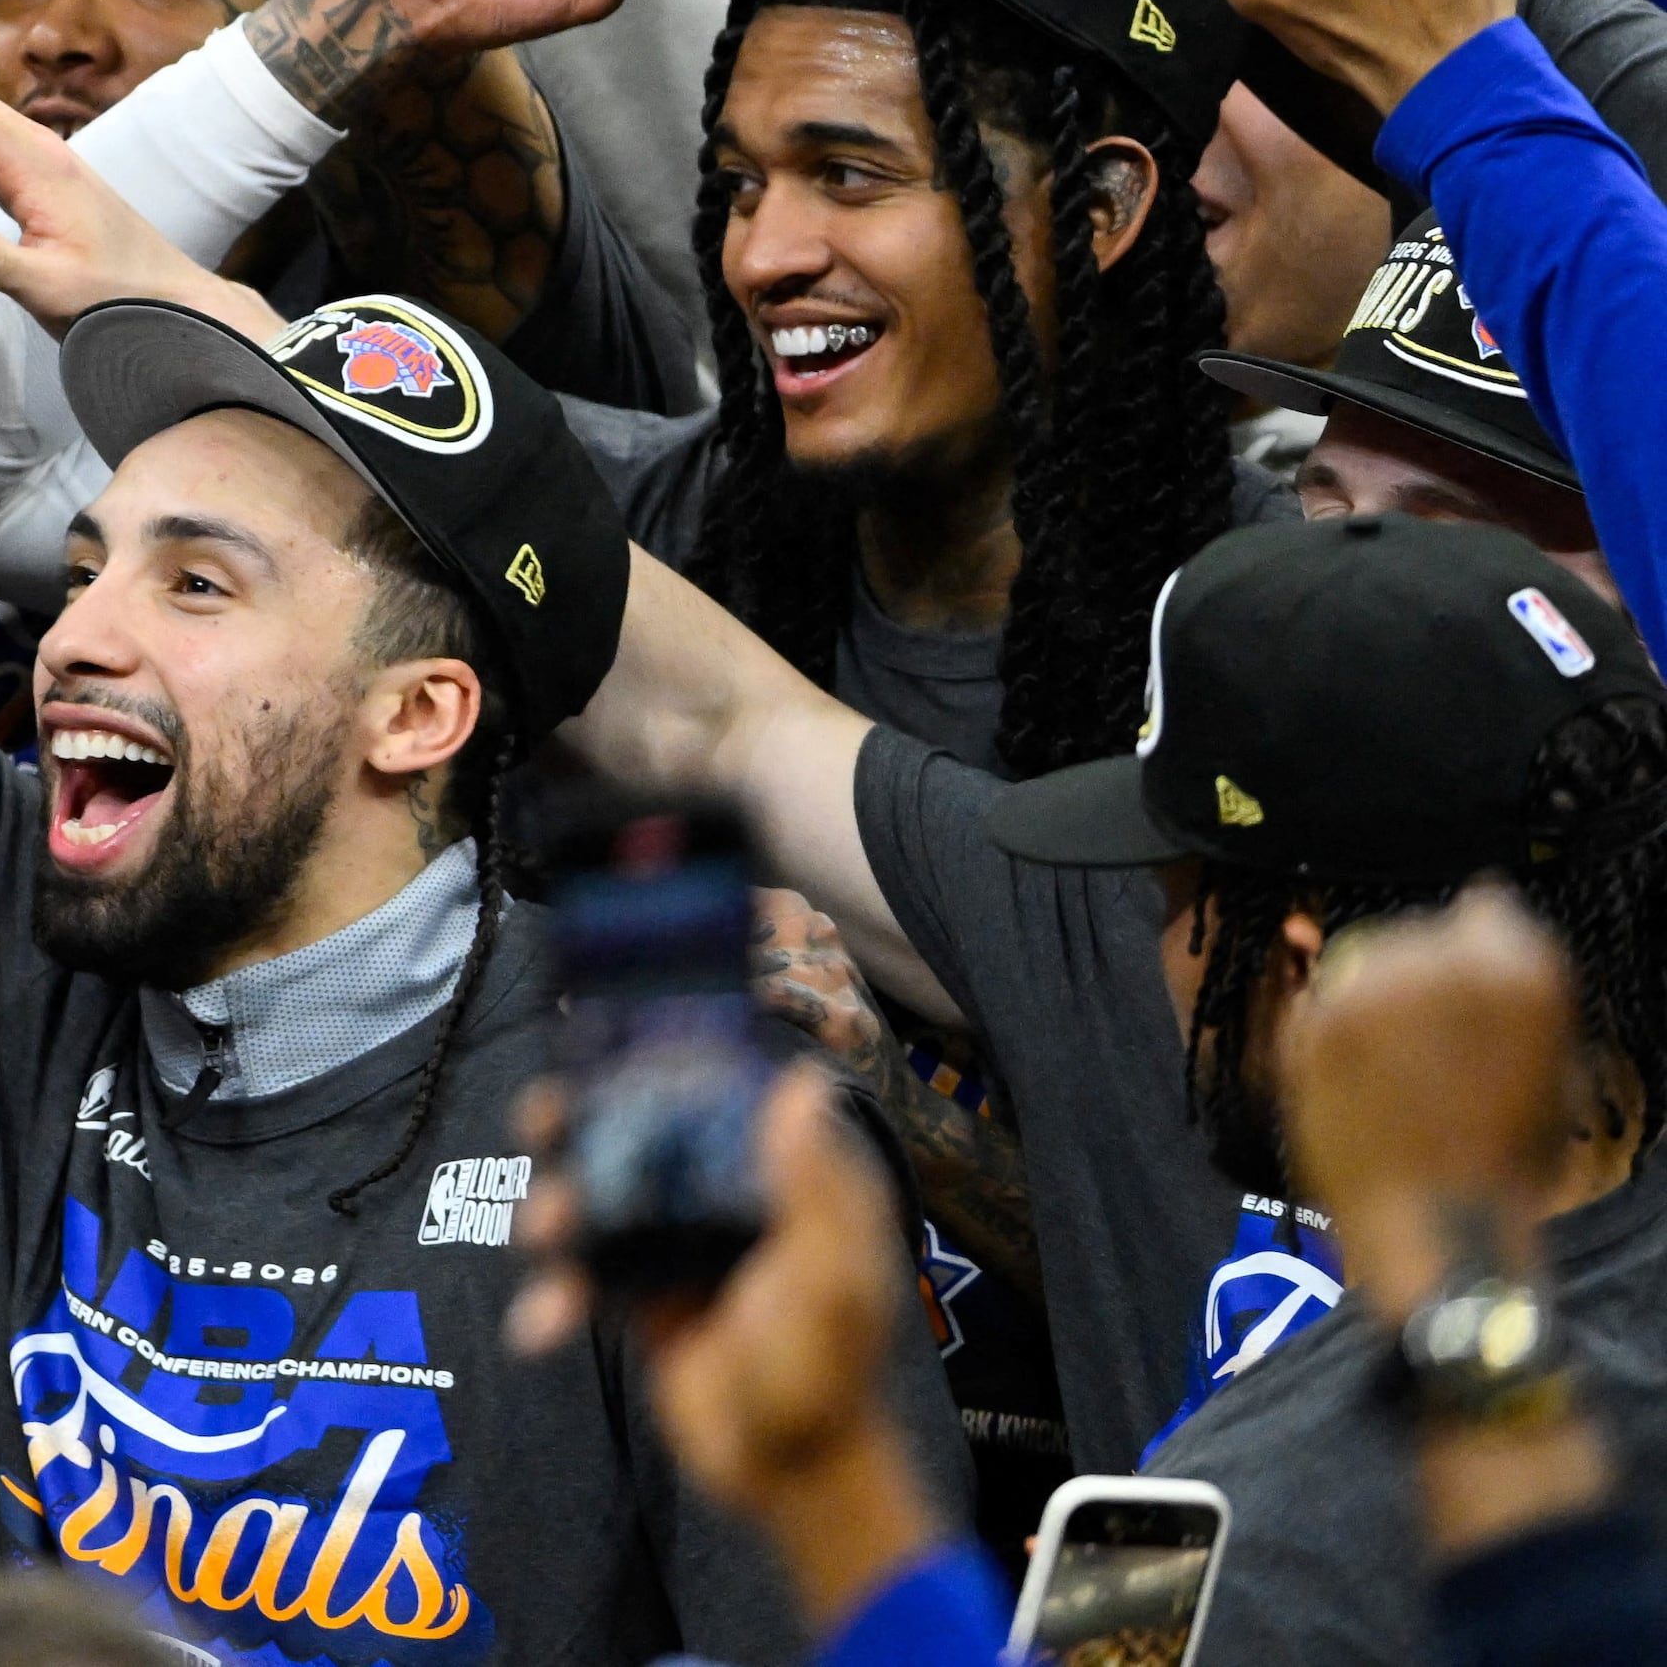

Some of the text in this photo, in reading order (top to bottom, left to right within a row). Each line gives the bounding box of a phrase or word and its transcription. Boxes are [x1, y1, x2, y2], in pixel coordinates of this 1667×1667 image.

[1388, 241, 1454, 265] 2026 NB
[342, 325, 439, 392] KNICKS
[467, 1155, 532, 1201] LOCKER
[1241, 1192, 1333, 1231] EASERN
[146, 1238, 339, 1285] 225-2026
[117, 1326, 278, 1380] CONFERENCE
[276, 1358, 454, 1389] CHAMPIONS
